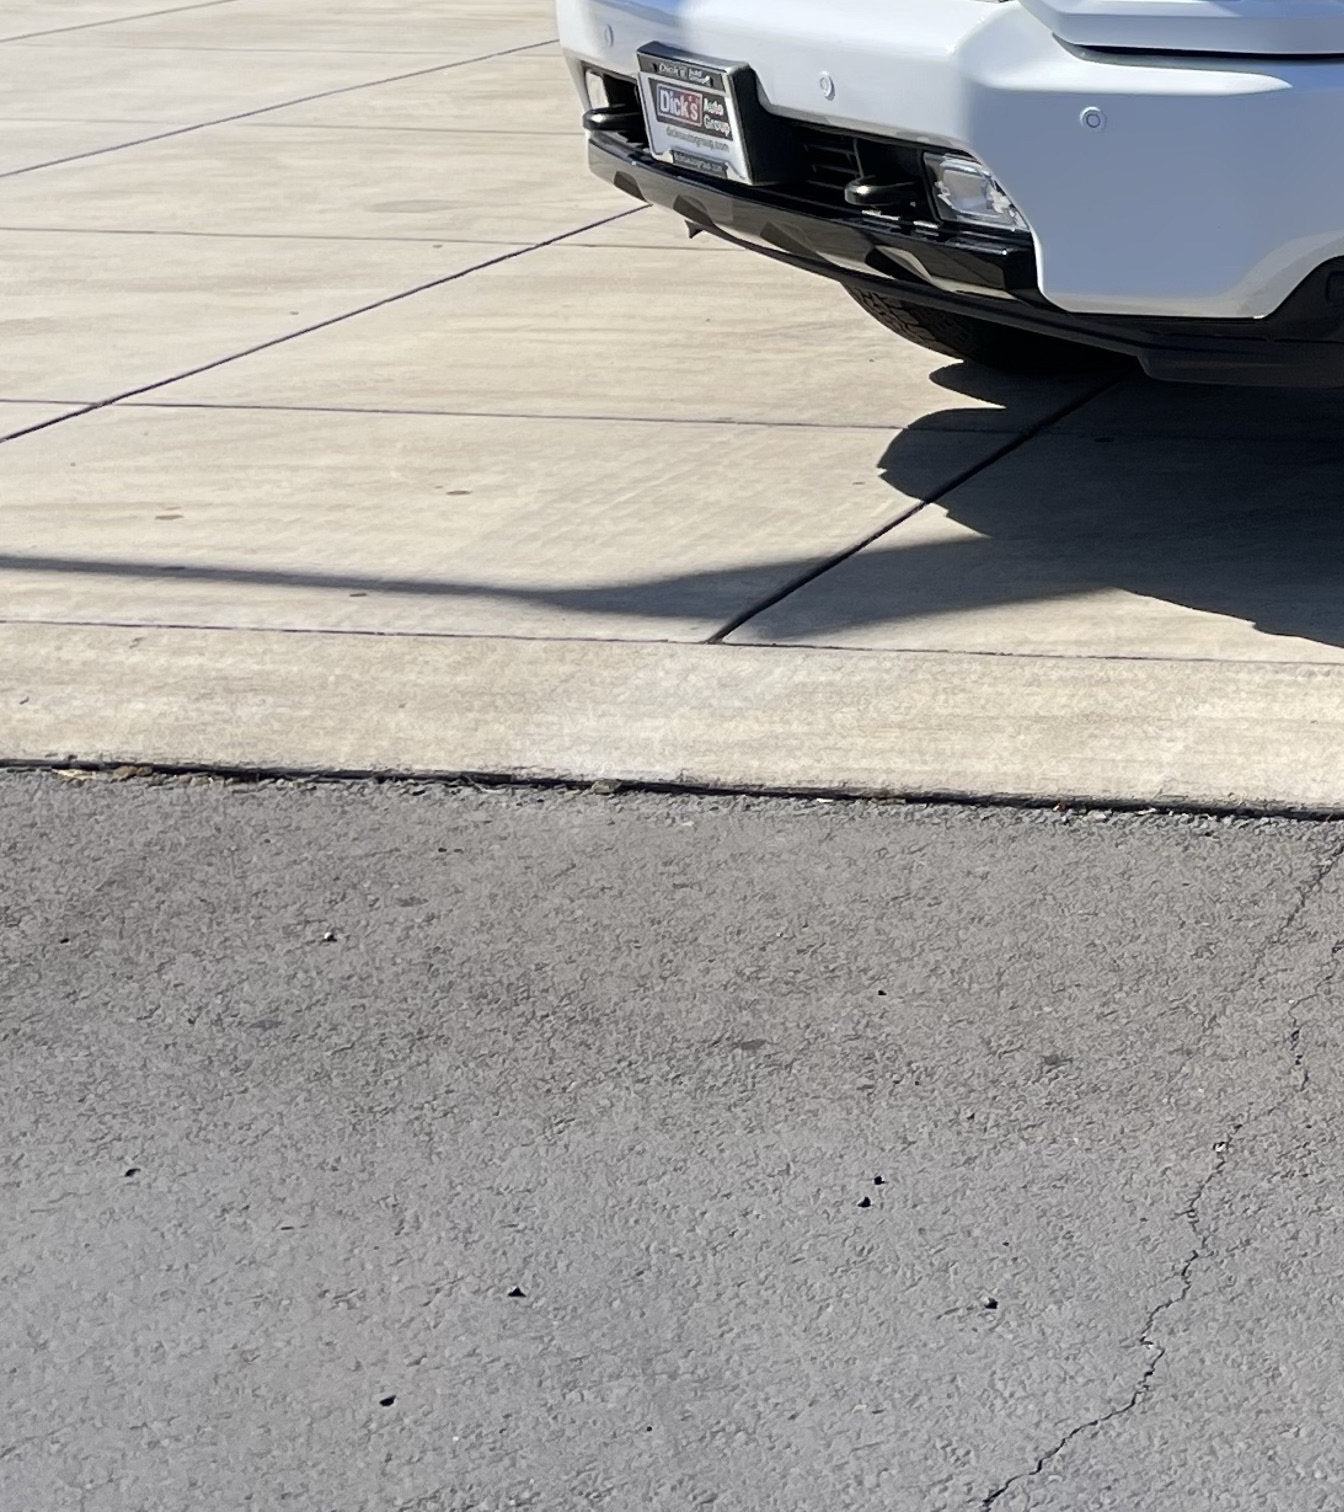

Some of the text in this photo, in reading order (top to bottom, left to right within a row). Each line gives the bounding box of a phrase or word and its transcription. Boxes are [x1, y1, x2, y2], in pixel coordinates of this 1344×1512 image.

[660, 90, 698, 121] Dick's
[703, 98, 724, 116] Auto
[703, 115, 730, 136] Group
